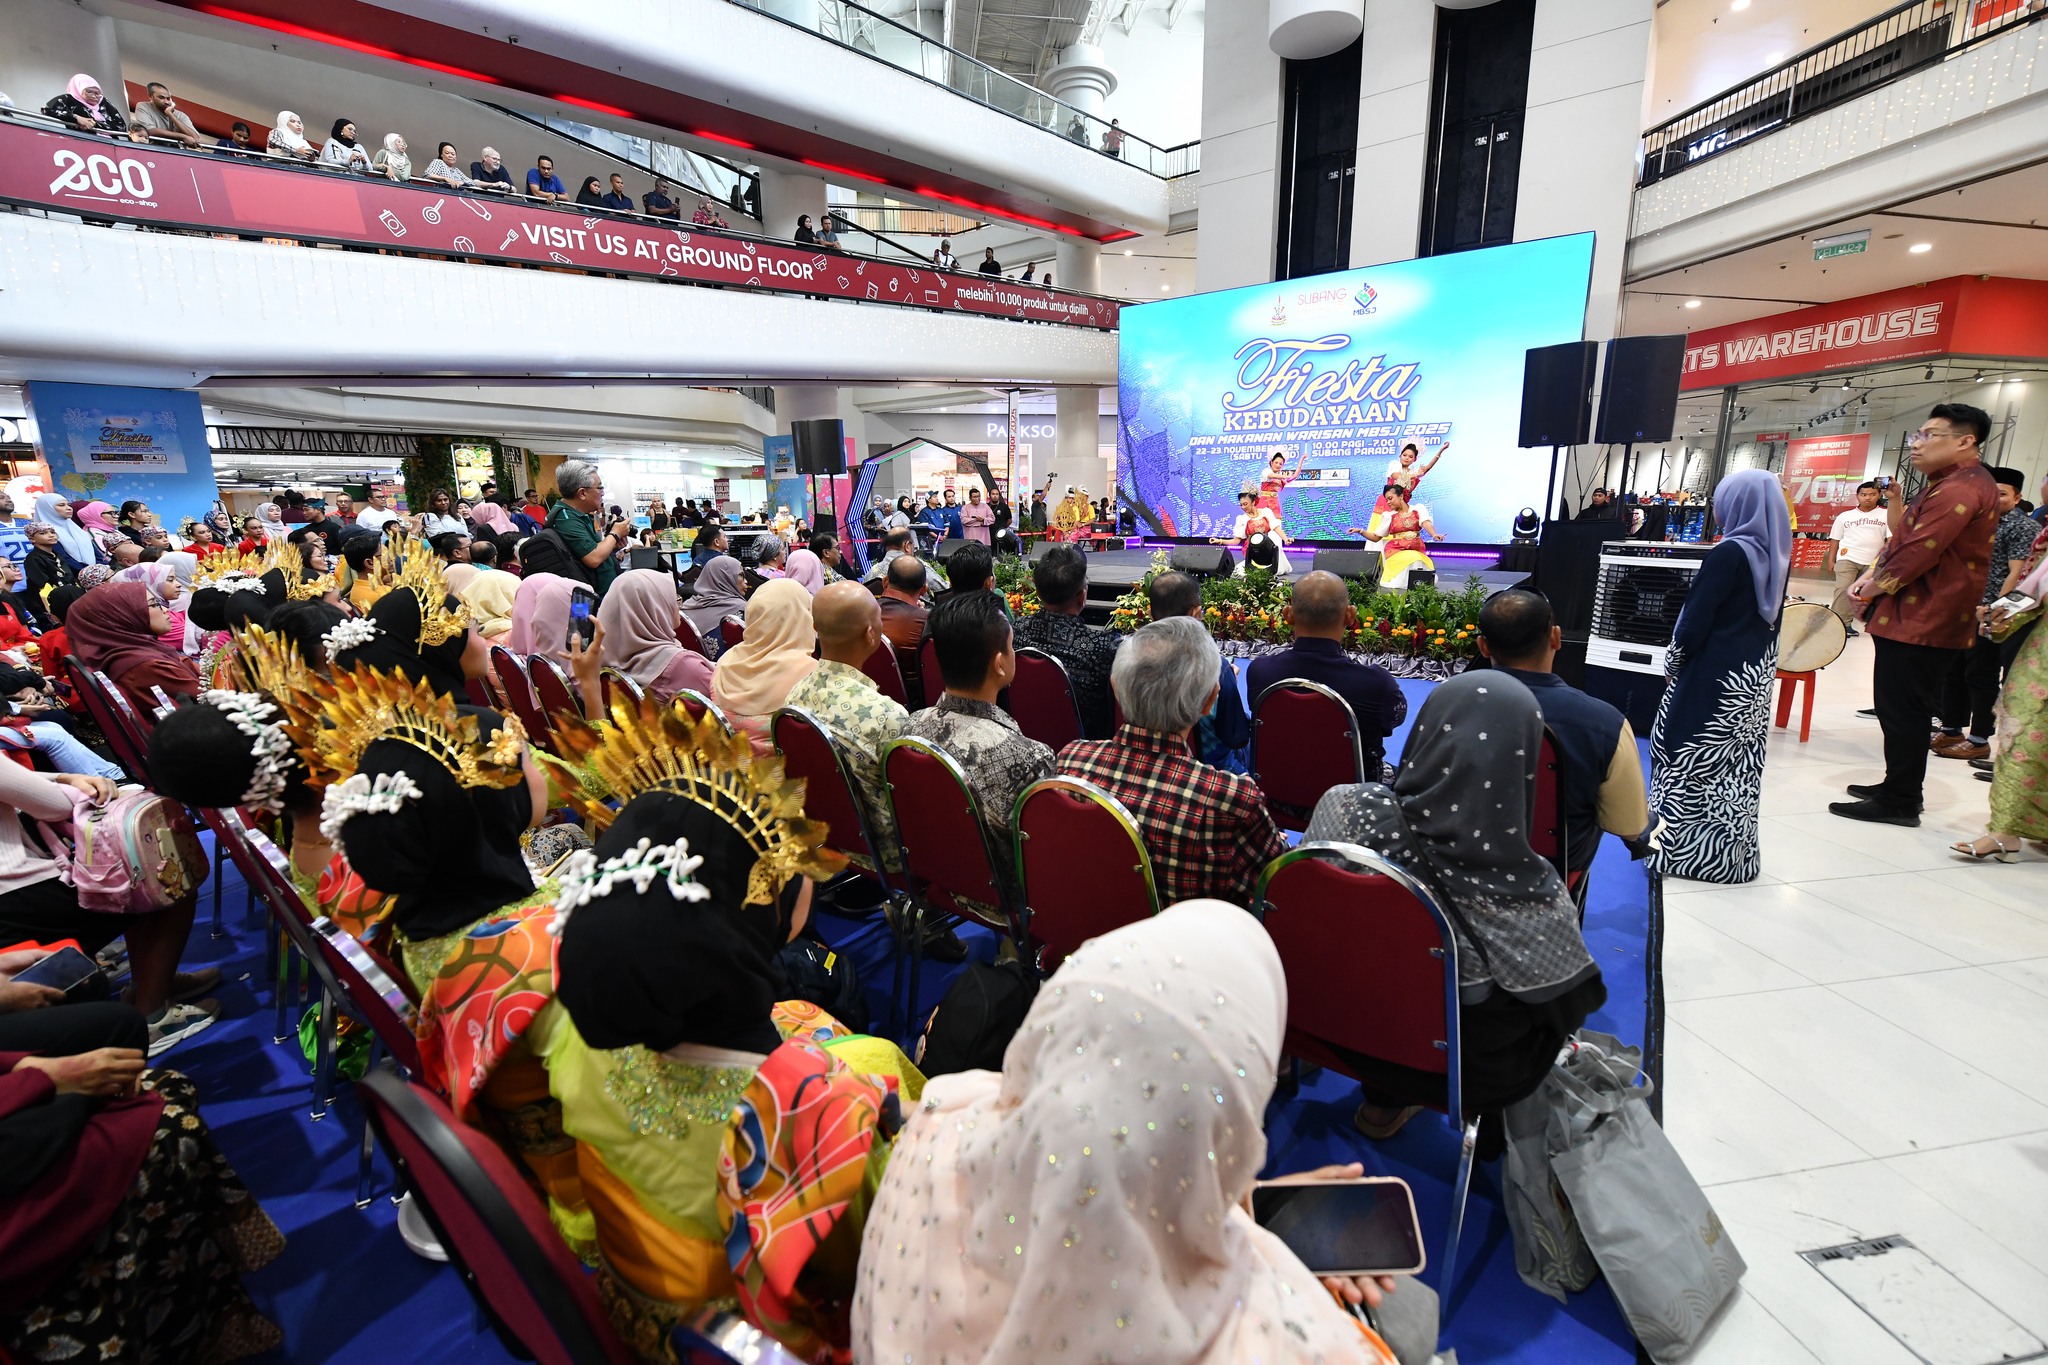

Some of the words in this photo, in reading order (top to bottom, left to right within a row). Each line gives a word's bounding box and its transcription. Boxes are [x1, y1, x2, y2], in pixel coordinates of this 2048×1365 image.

[119, 199, 158, 208] eco-shop
[521, 222, 586, 250] VISIT
[594, 233, 628, 256] US
[634, 239, 660, 260] AT
[665, 244, 753, 272] GROUND
[757, 257, 814, 281] FLOOR
[957, 286, 994, 302] melebihi
[995, 292, 1022, 306] 10,000
[1023, 298, 1048, 310] produk
[1049, 301, 1068, 312] untuk
[1069, 303, 1089, 316] dipilih
[1298, 288, 1347, 305] SUBANG
[1353, 307, 1377, 315] MBSJ
[1724, 302, 1944, 366] WAREHOUSE
[1222, 334, 1422, 411] Fiesta
[1223, 400, 1410, 431] KEBUDAYAAN
[987, 423, 1055, 438] PAKSO
[1189, 436, 1215, 446] DAN
[1217, 432, 1284, 445] MAKANAN
[1286, 428, 1355, 441] WARISAN
[1357, 425, 1401, 438] MBSJ
[1403, 422, 1452, 436] 2025
[1196, 447, 1222, 455] 22-23
[1312, 441, 1338, 449] 10.00
[1341, 440, 1365, 448] PAGI
[1230, 452, 1262, 461] (SABTU
[1312, 448, 1352, 457] SUBANG
[1354, 446, 1396, 456] PARADE
[1803, 448, 1850, 457] WAREHOUSE
[1844, 518, 1886, 529] Gryffindor
